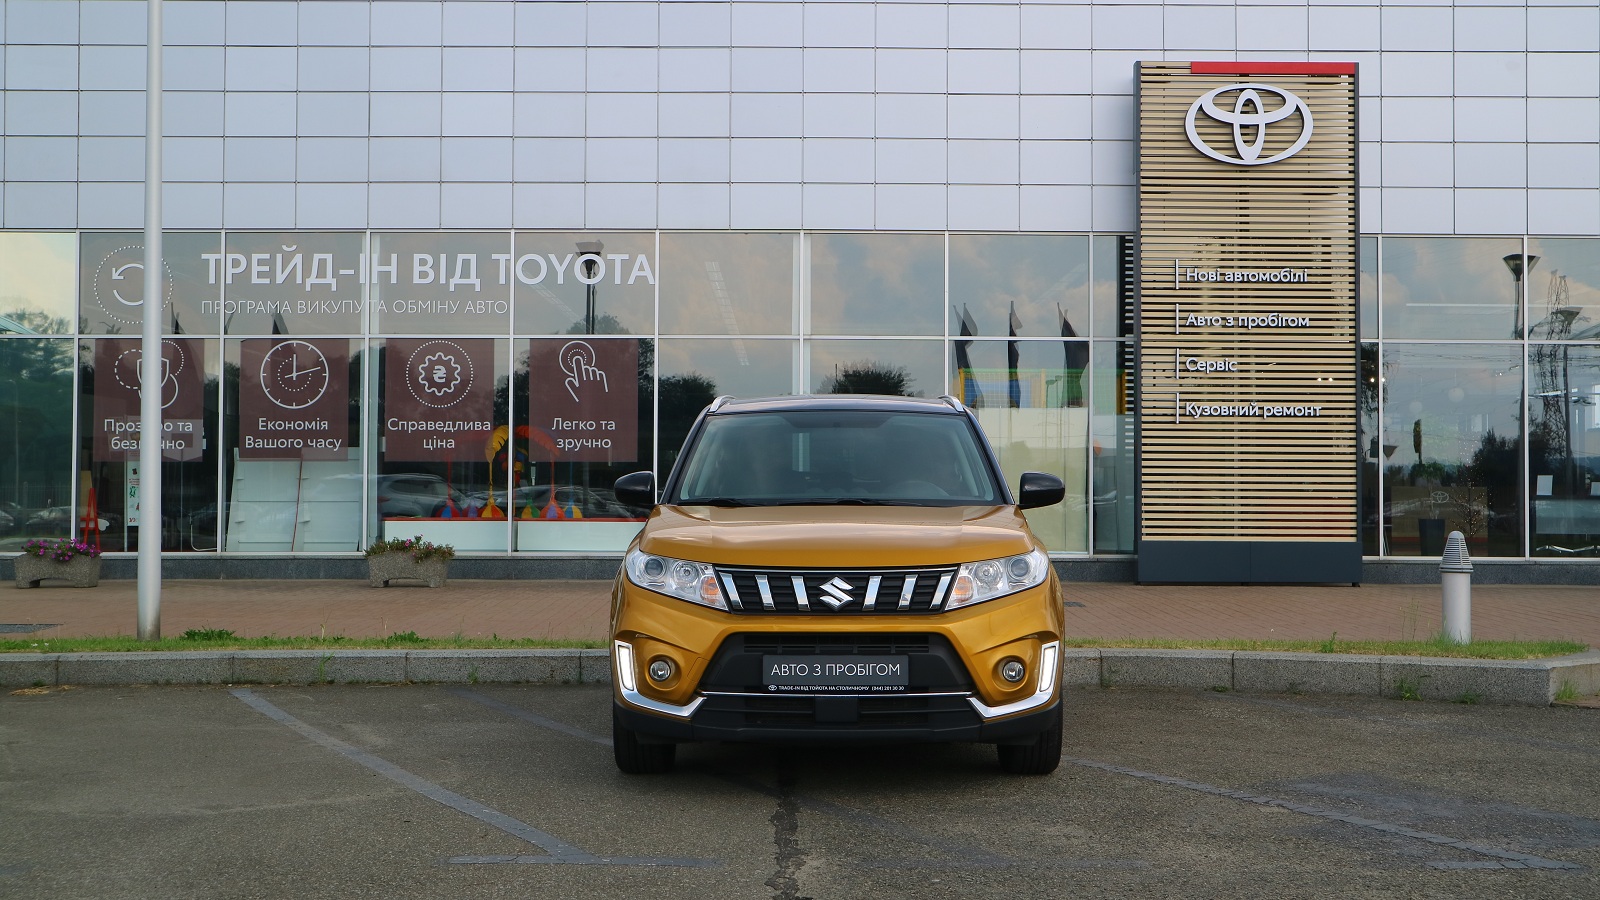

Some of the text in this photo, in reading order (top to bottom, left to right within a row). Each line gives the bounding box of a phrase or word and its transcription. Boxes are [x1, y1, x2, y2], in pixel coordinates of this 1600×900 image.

[201, 244, 655, 291] ТРЕЙД-ІН ВІД TOYOTA
[1186, 268, 1308, 282] Нові автомобілі
[201, 300, 292, 314] ПРОГРАМА
[297, 300, 364, 314] ВИКУПУ
[393, 300, 460, 314] ОБМІНУ
[464, 300, 508, 314] АВТО
[1186, 313, 1310, 330] Авто з пробігом
[1186, 358, 1238, 374] Сервіс
[1185, 402, 1322, 419] Кузовний ремонт
[104, 419, 193, 434] Прозо та
[258, 418, 328, 430] Економія
[387, 418, 491, 433] Справедлива
[551, 418, 615, 430] Легко та
[245, 436, 342, 451] Вашого часу
[423, 436, 455, 450] ціна
[556, 438, 611, 451] зручно
[770, 664, 809, 676] АВТО
[825, 664, 900, 676] ПРОБІГОМ
